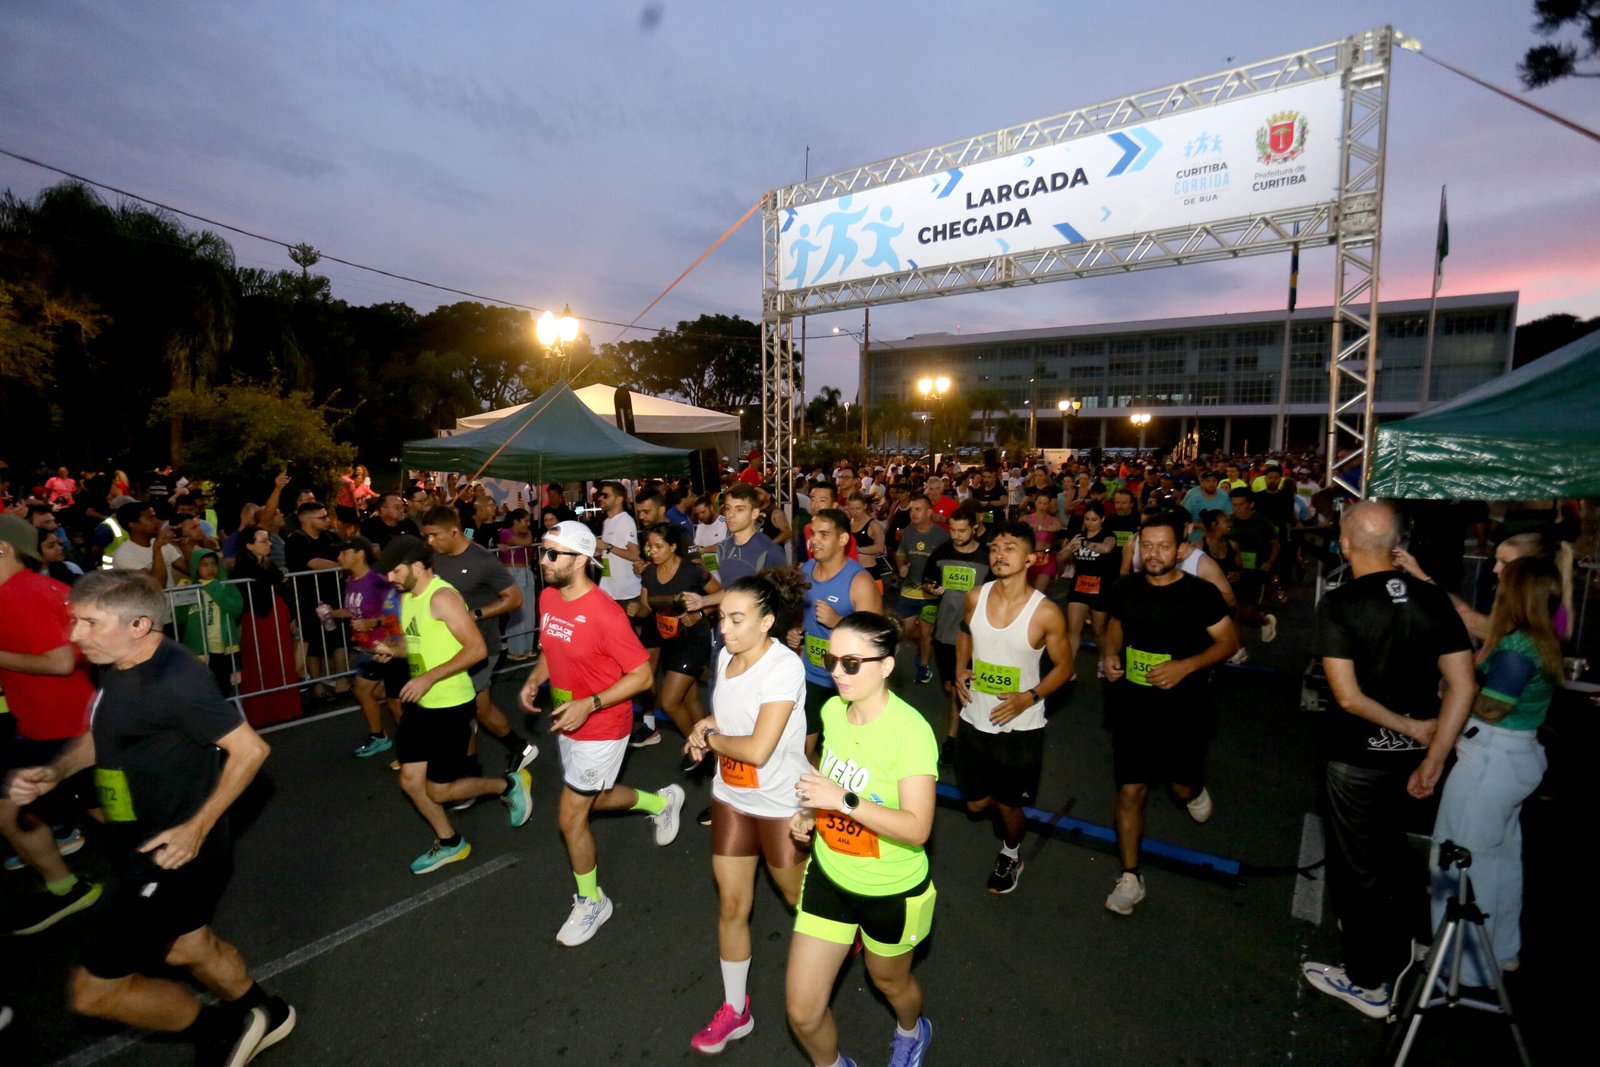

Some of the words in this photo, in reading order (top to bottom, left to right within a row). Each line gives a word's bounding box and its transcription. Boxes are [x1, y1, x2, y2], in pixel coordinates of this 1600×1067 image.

[1176, 162, 1228, 179] CURITIBA
[1254, 168, 1293, 180] Prefeitura
[1294, 165, 1306, 174] de
[966, 167, 1089, 210] LARGADA
[1174, 173, 1230, 195] CORRIDA
[1252, 174, 1307, 192] CURITIBA
[1184, 198, 1196, 206] DE
[1199, 194, 1218, 204] RUA
[917, 207, 1032, 245] CHEGADA
[949, 573, 969, 582] 4541
[810, 645, 830, 658] 550
[980, 672, 1012, 686] 4638
[826, 813, 865, 838] 3367
[837, 837, 851, 846] ANA
